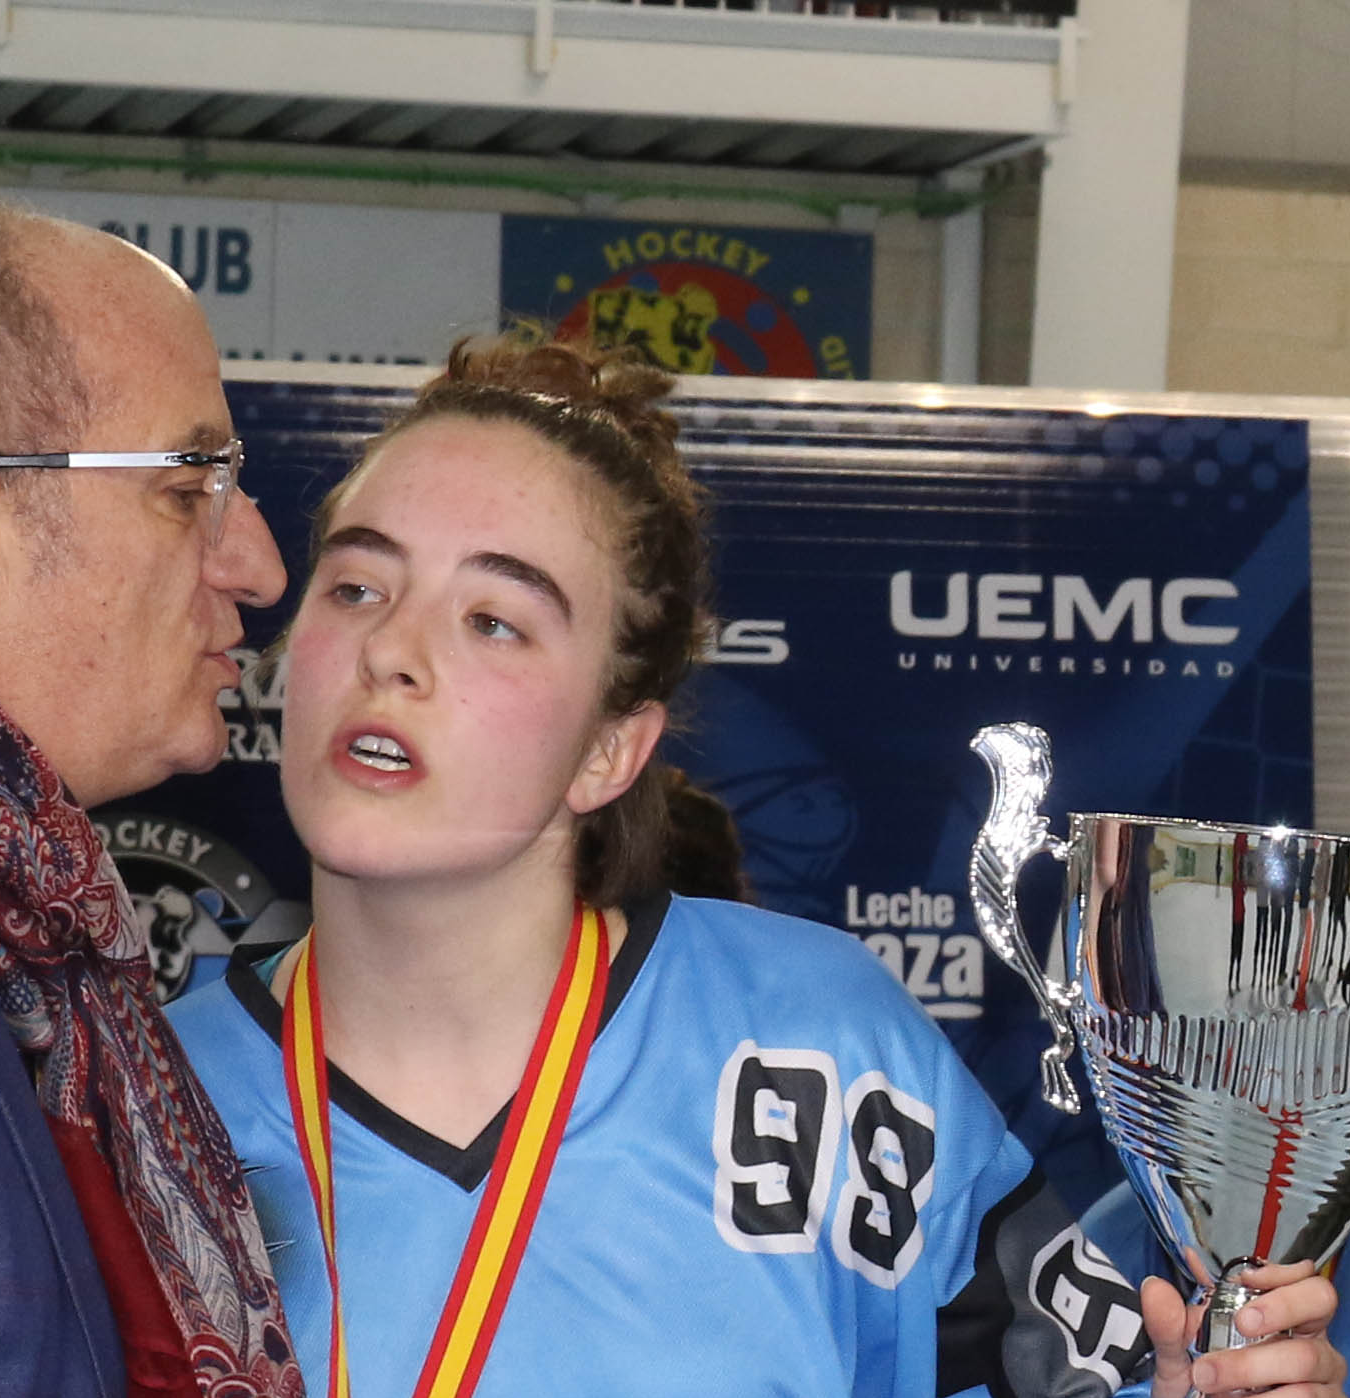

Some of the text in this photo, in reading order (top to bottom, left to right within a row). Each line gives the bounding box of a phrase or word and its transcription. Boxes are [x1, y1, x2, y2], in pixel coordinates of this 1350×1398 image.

[603, 229, 772, 276] HOCKEY
[889, 570, 1240, 646] UEMC
[899, 653, 1236, 680] UNIVERSIDAD
[846, 885, 956, 929] Leche
[849, 932, 985, 999] aza
